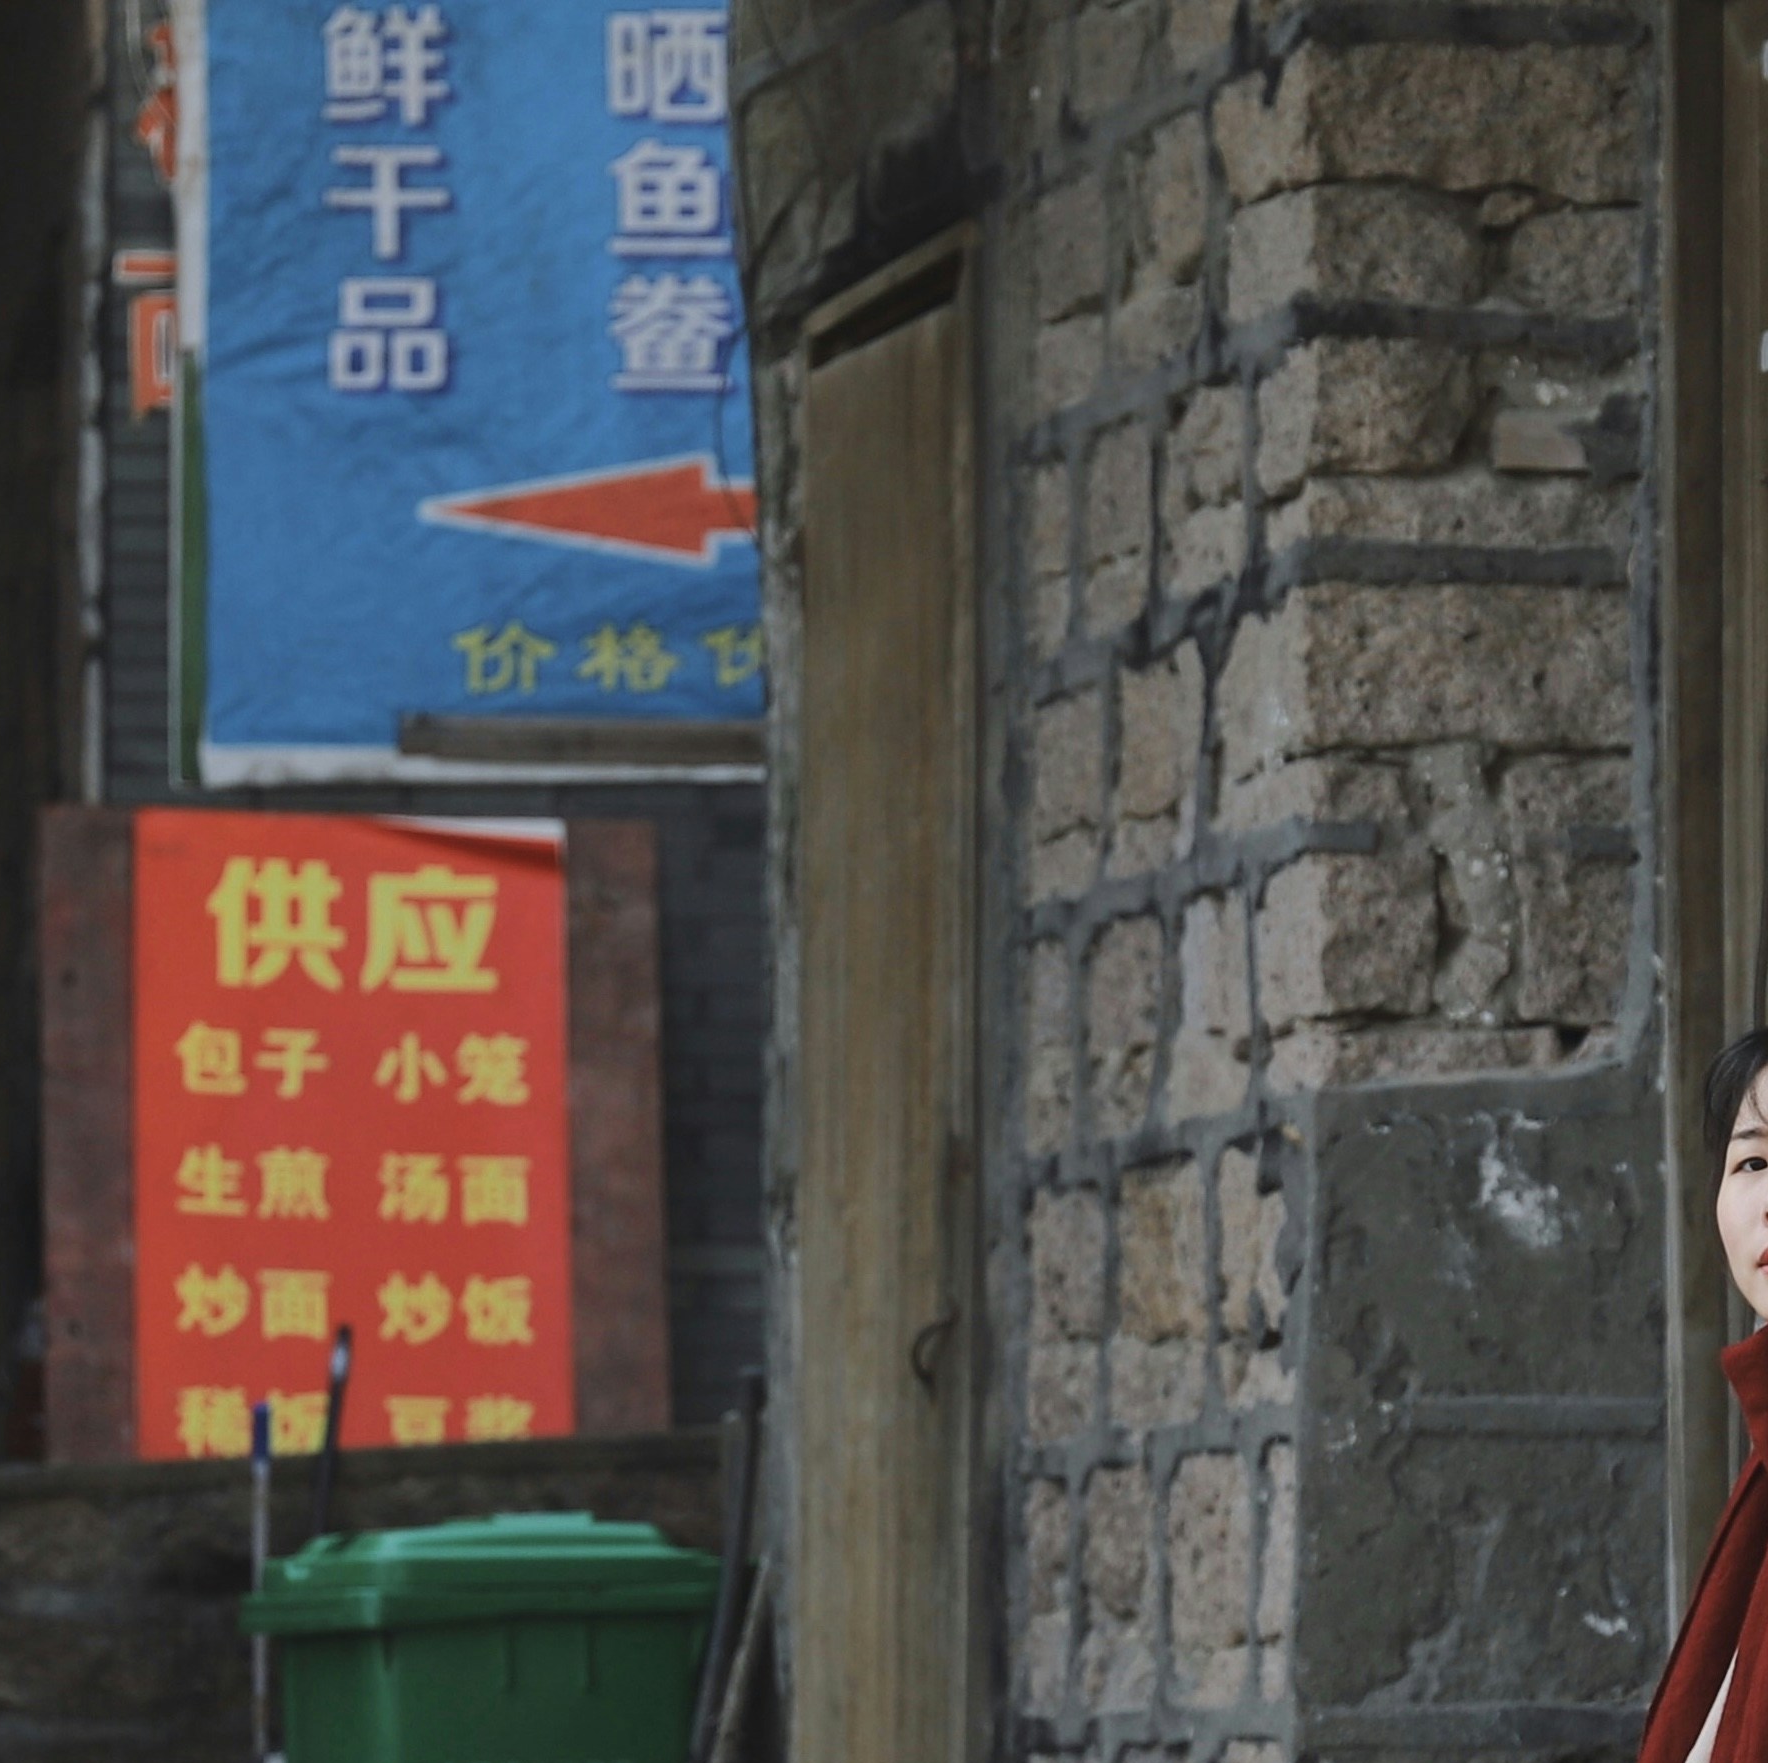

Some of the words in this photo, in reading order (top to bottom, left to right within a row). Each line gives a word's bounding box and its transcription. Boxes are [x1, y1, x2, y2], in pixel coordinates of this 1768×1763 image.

[321, 4, 450, 394] 鲜干品
[207, 856, 501, 992] 供应
[176, 1020, 331, 1098] 包子
[374, 1032, 531, 1106] 小笼
[177, 1144, 331, 1220] 生煎
[378, 1150, 531, 1226] 汤面
[176, 1264, 332, 1340] 炒面
[376, 1272, 534, 1346] 炒饭
